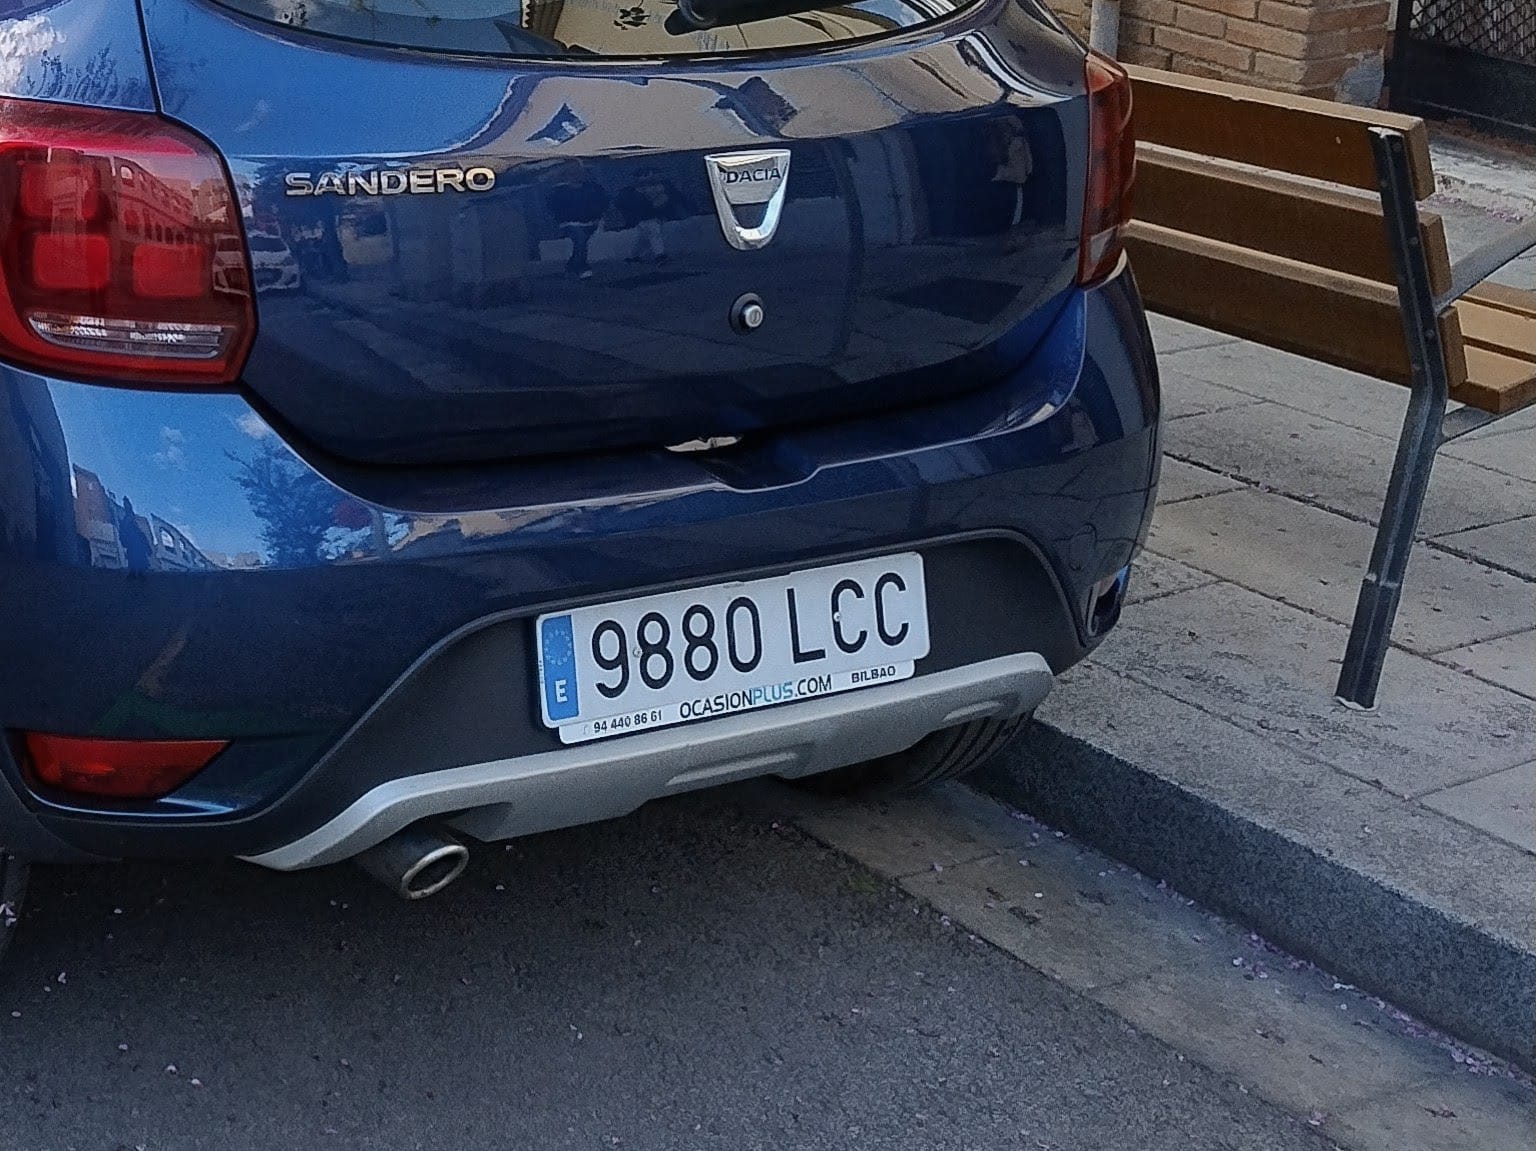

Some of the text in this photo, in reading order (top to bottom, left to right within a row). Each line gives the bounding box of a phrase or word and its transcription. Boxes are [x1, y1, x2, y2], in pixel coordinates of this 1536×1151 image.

[285, 167, 496, 196] SANDERO
[726, 167, 781, 183] DACIA
[591, 572, 910, 699] 9880 LCC
[851, 665, 896, 685] BILBAO
[555, 679, 568, 703] E
[679, 674, 833, 719] OCASIONPLUS.COM
[593, 710, 663, 734] 94 440 86 61
